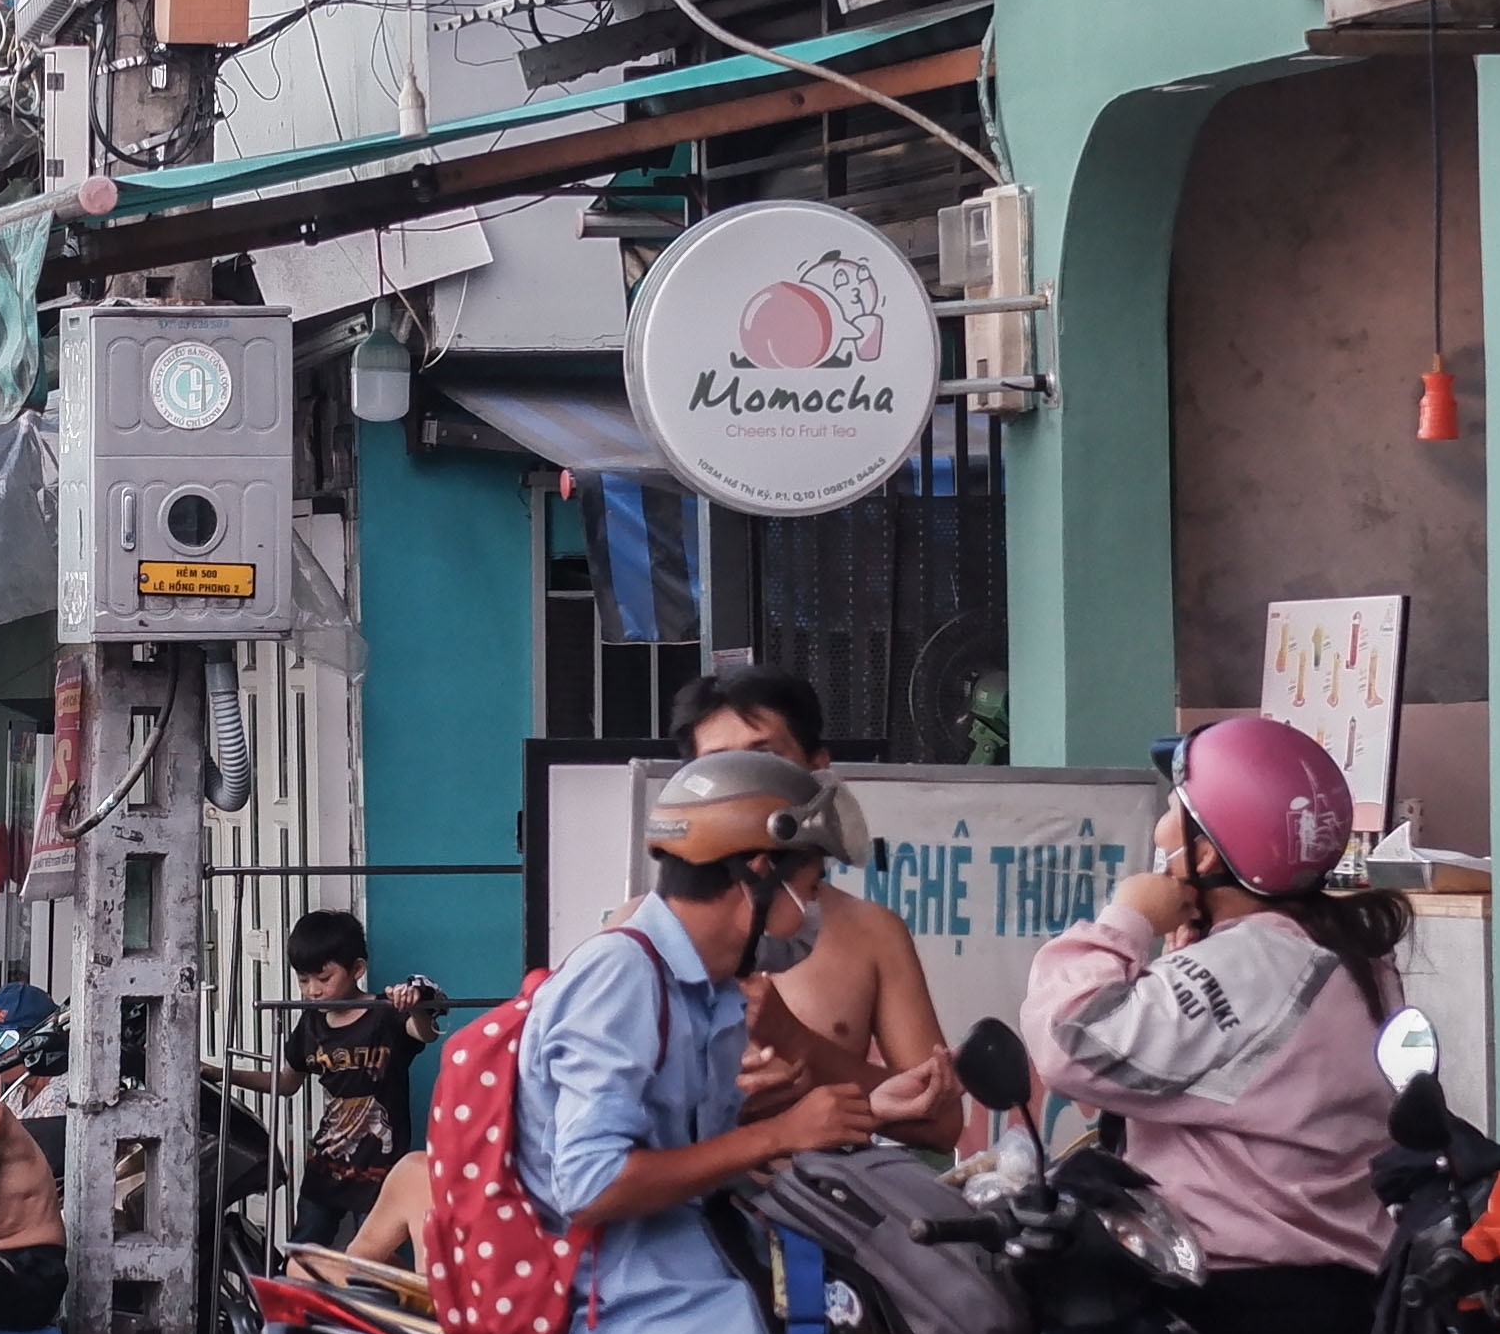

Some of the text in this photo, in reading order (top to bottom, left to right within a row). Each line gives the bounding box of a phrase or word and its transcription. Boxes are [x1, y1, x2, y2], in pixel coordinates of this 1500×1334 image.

[688, 369, 895, 415] Momocha
[725, 423, 857, 439] Cheers to Fruit Tea
[823, 478, 856, 496] 09876
[201, 569, 218, 579] 500
[153, 580, 165, 591] LÊ
[198, 583, 231, 593] PHONG
[234, 584, 240, 594] 2
[863, 818, 1126, 956] NGHỆ THUẬT
